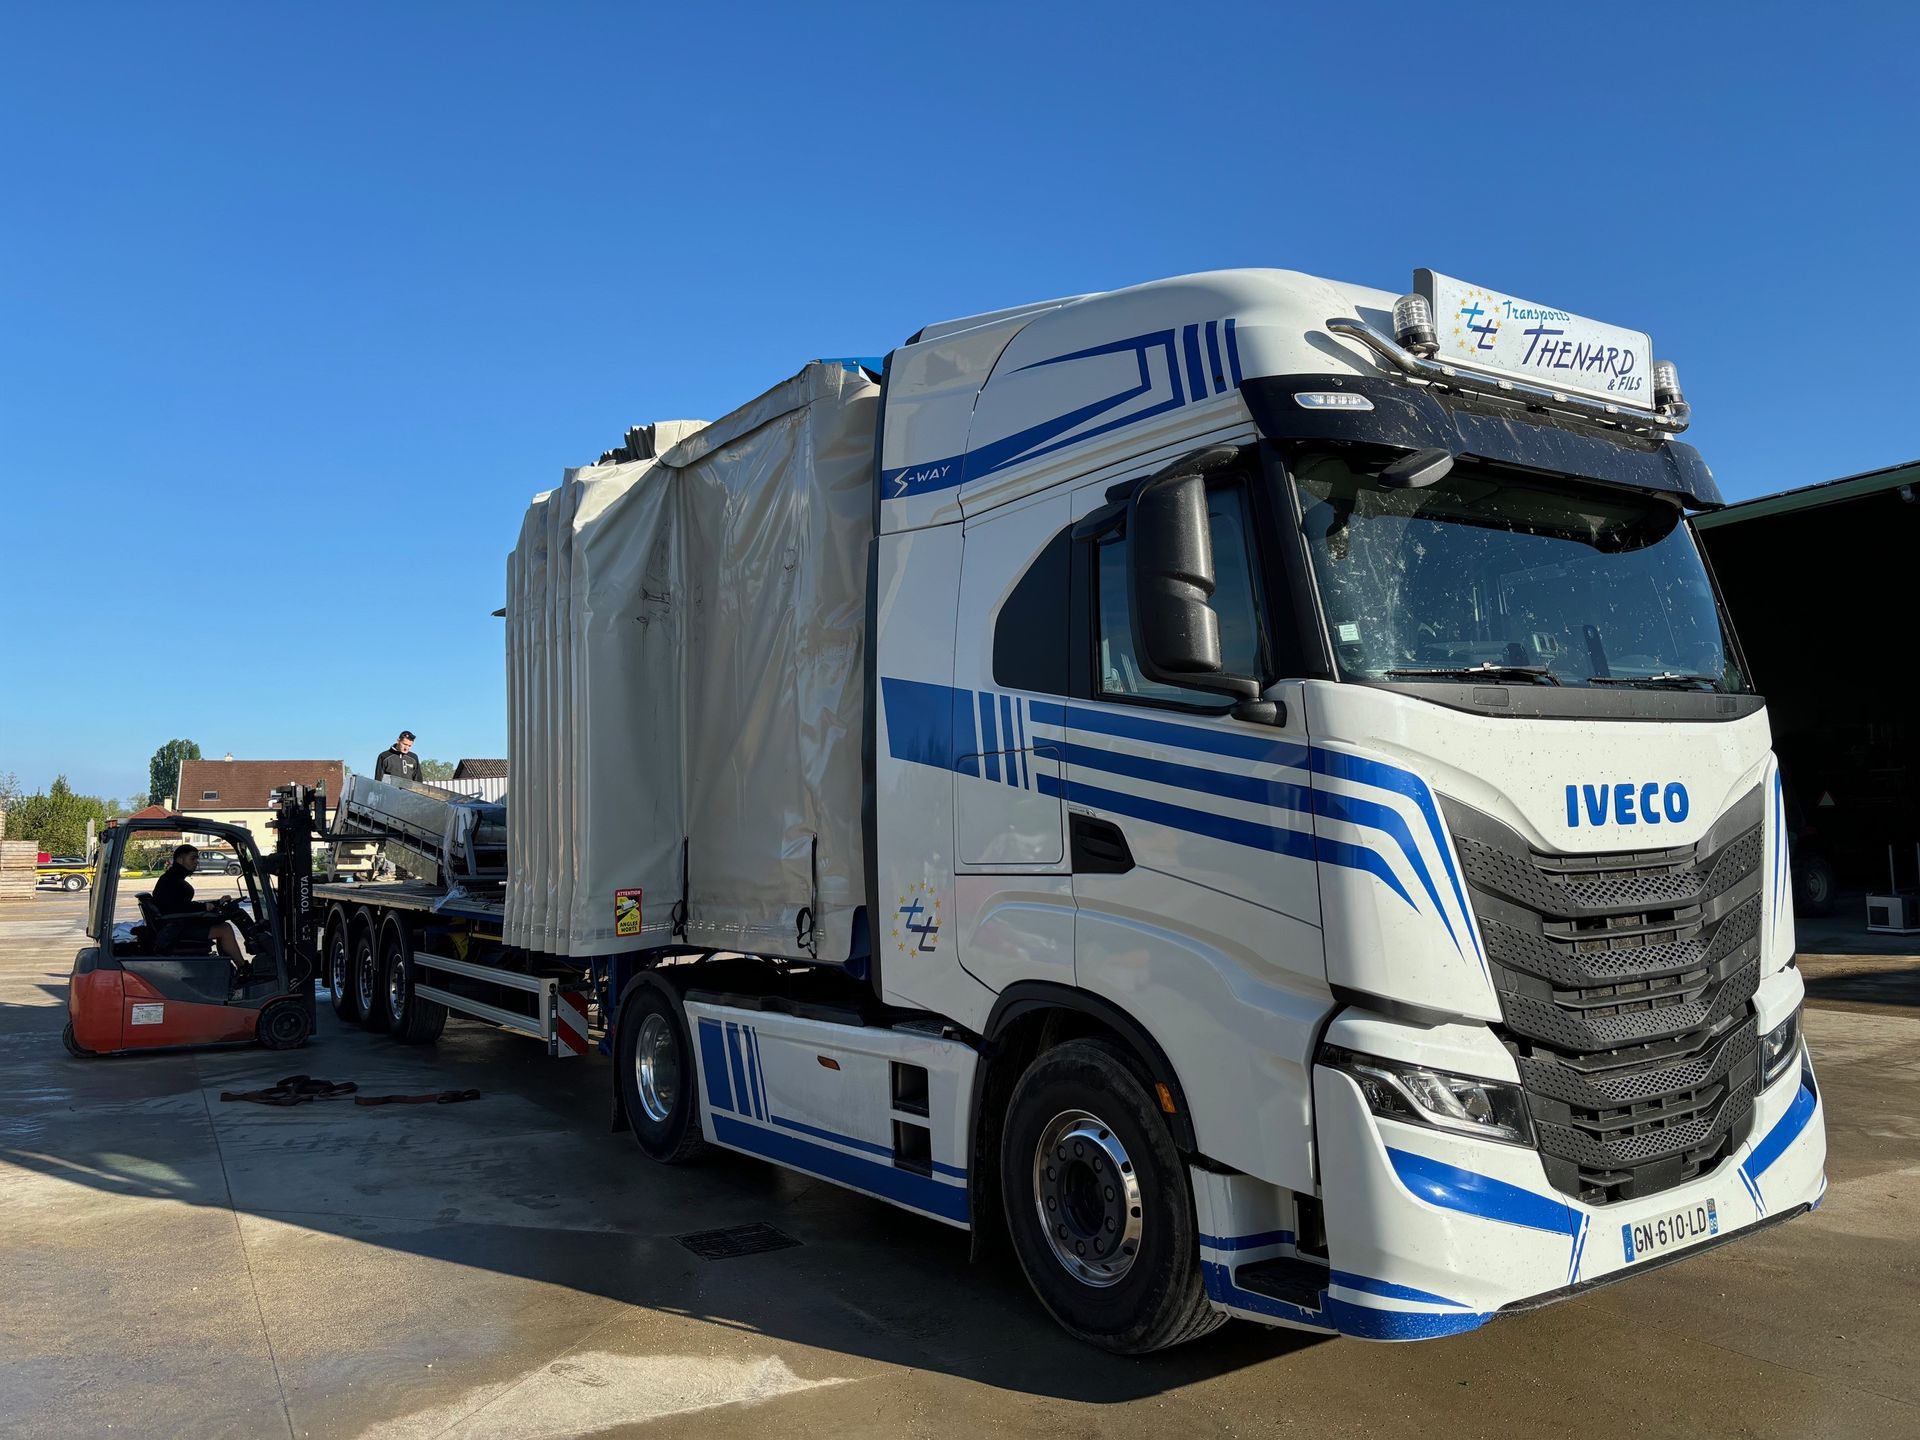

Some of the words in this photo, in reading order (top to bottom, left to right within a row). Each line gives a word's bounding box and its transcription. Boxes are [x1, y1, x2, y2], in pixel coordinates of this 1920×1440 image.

[1502, 300, 1570, 325] Transports
[1521, 324, 1635, 378] THENARD
[1607, 376, 1616, 391] &
[1617, 375, 1642, 391] FILS
[1565, 781, 1689, 827] IVECO
[300, 875, 310, 914] TOYOTA
[1634, 1207, 1707, 1253] GN-610-LD
